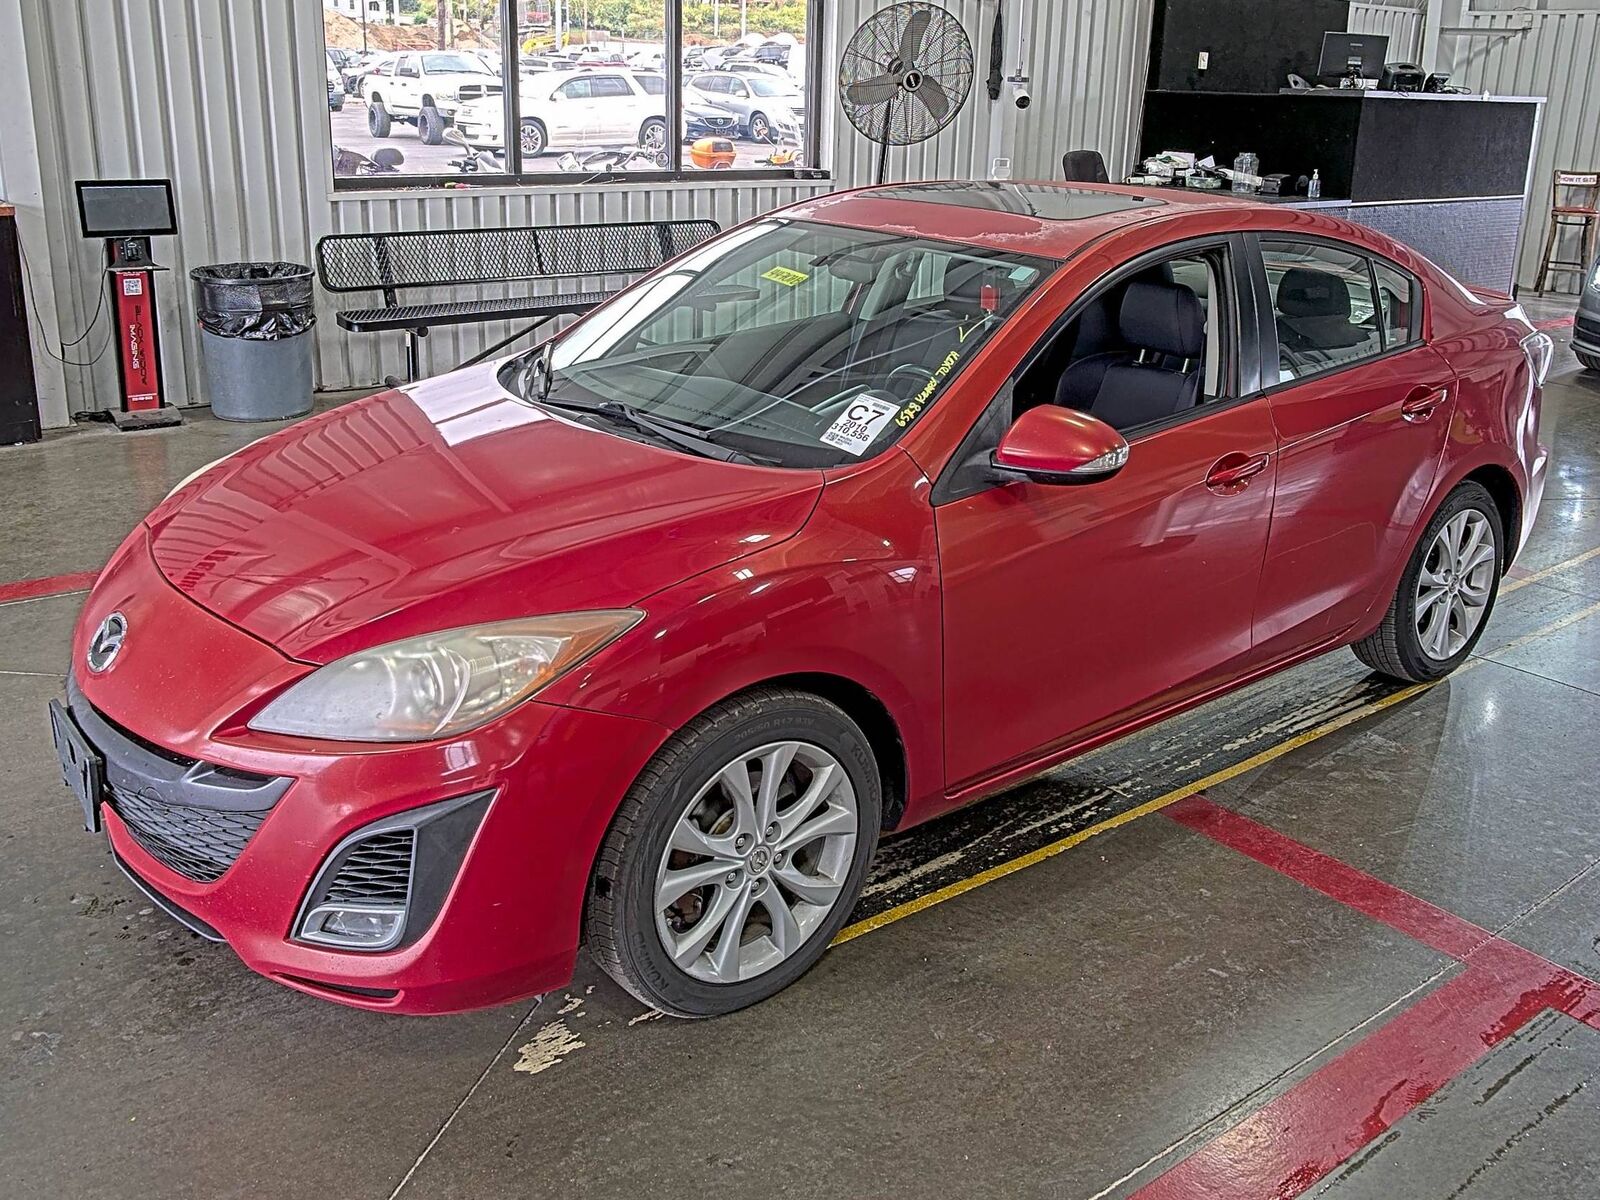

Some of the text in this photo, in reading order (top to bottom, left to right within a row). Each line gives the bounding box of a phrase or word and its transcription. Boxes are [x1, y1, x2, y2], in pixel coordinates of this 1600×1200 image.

[135, 305, 144, 344] BLACK
[129, 324, 140, 369] IMAGING
[843, 419, 868, 433] 2010
[847, 404, 885, 426] C7
[831, 422, 870, 442] 310,556
